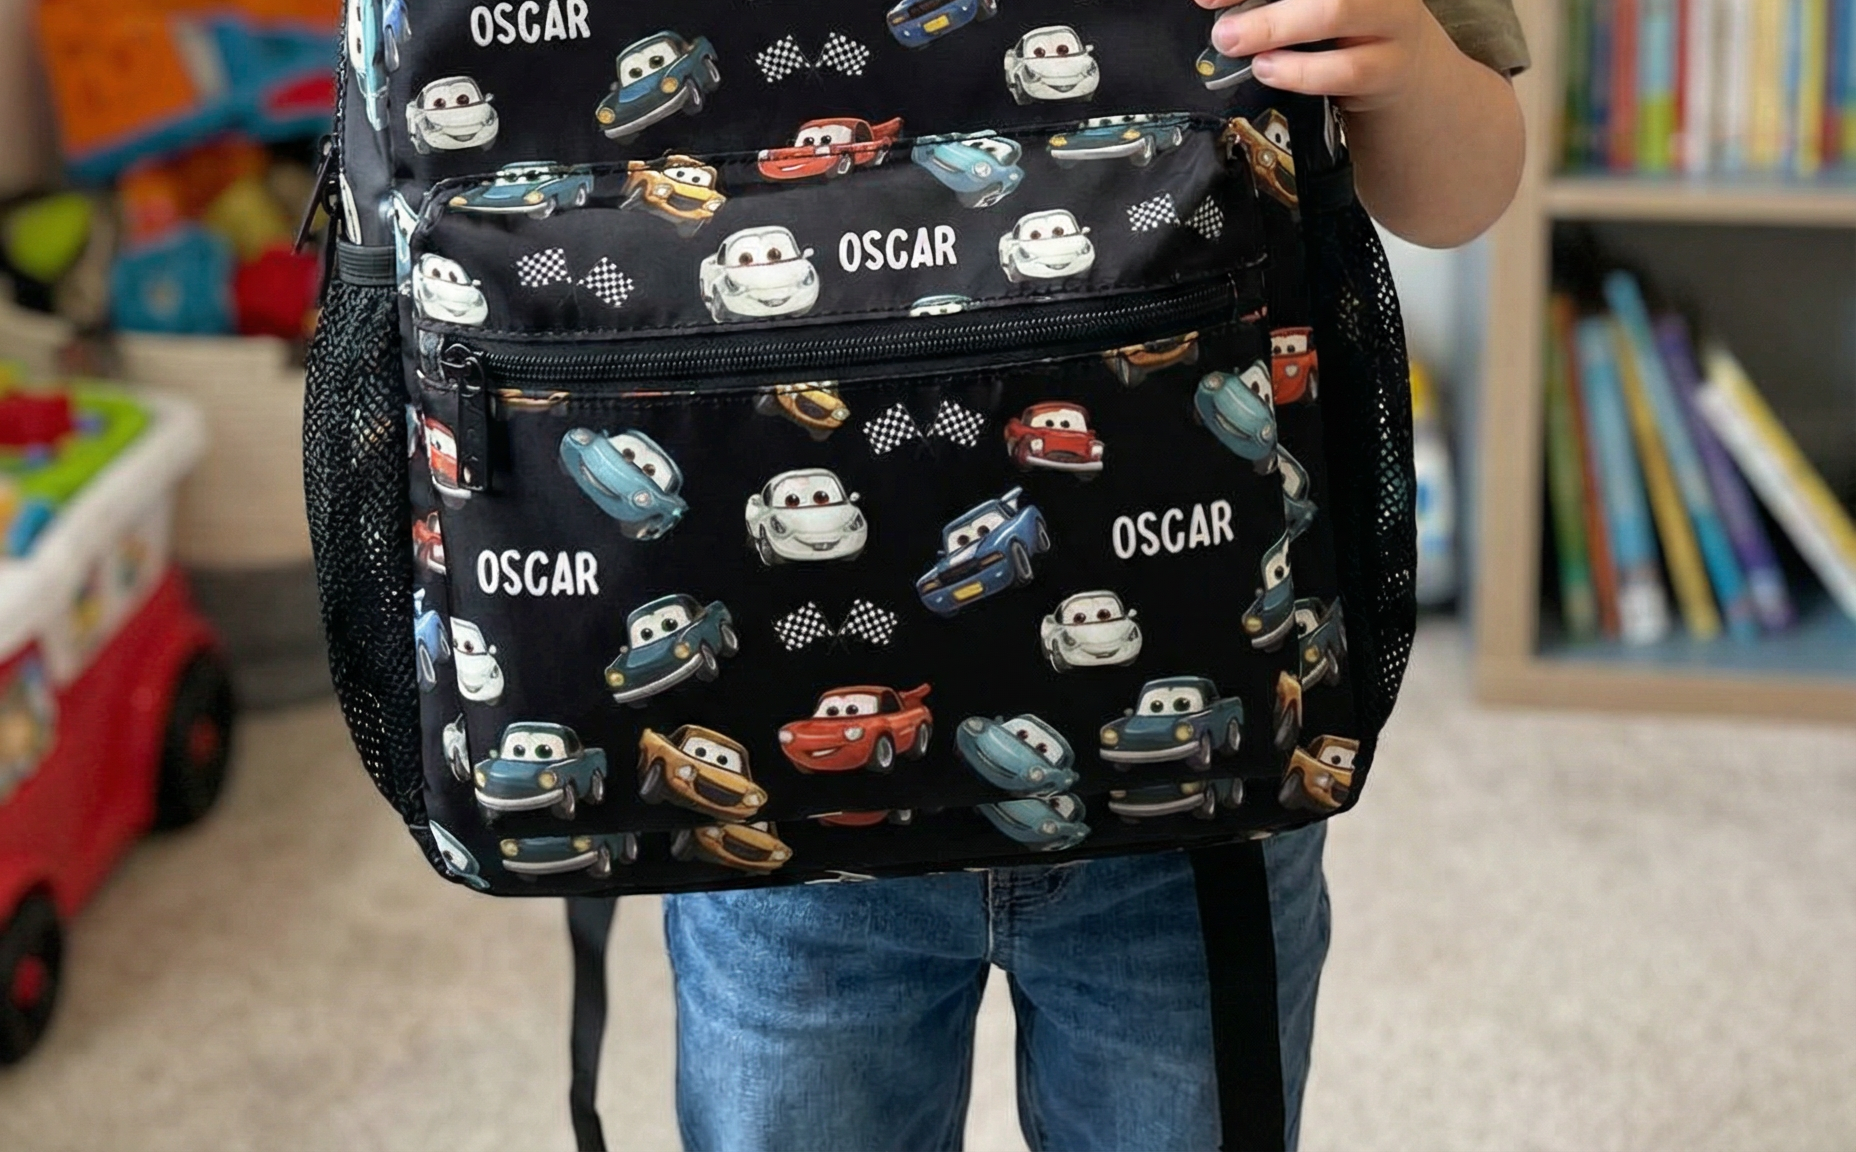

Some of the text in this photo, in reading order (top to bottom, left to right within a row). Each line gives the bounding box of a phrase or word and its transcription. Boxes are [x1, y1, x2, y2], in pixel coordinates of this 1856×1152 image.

[838, 224, 959, 273] OSCAR
[1112, 499, 1235, 560] OSCAR
[476, 549, 600, 597] OSCAR
